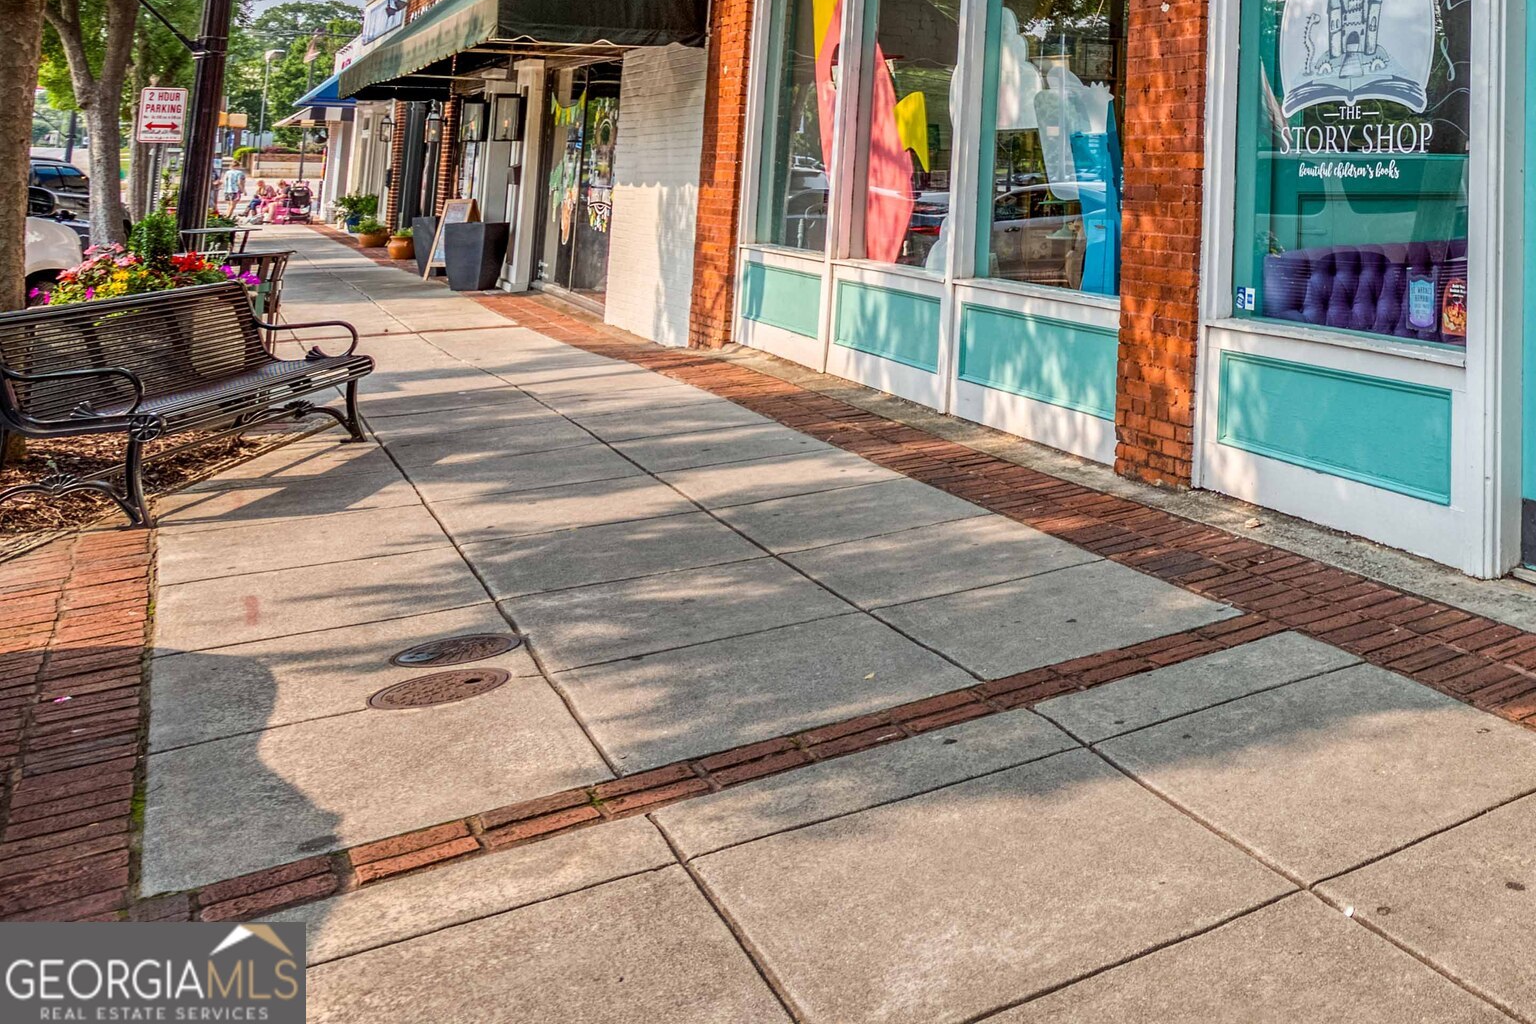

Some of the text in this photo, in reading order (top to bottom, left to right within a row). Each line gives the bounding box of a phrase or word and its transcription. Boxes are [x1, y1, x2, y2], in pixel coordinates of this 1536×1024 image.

[149, 91, 181, 102] 2 HOUR
[145, 103, 182, 114] PARKING
[1339, 105, 1362, 120] THE
[1280, 122, 1433, 155] STORY SHOP
[1299, 159, 1400, 179] beautiful children's books
